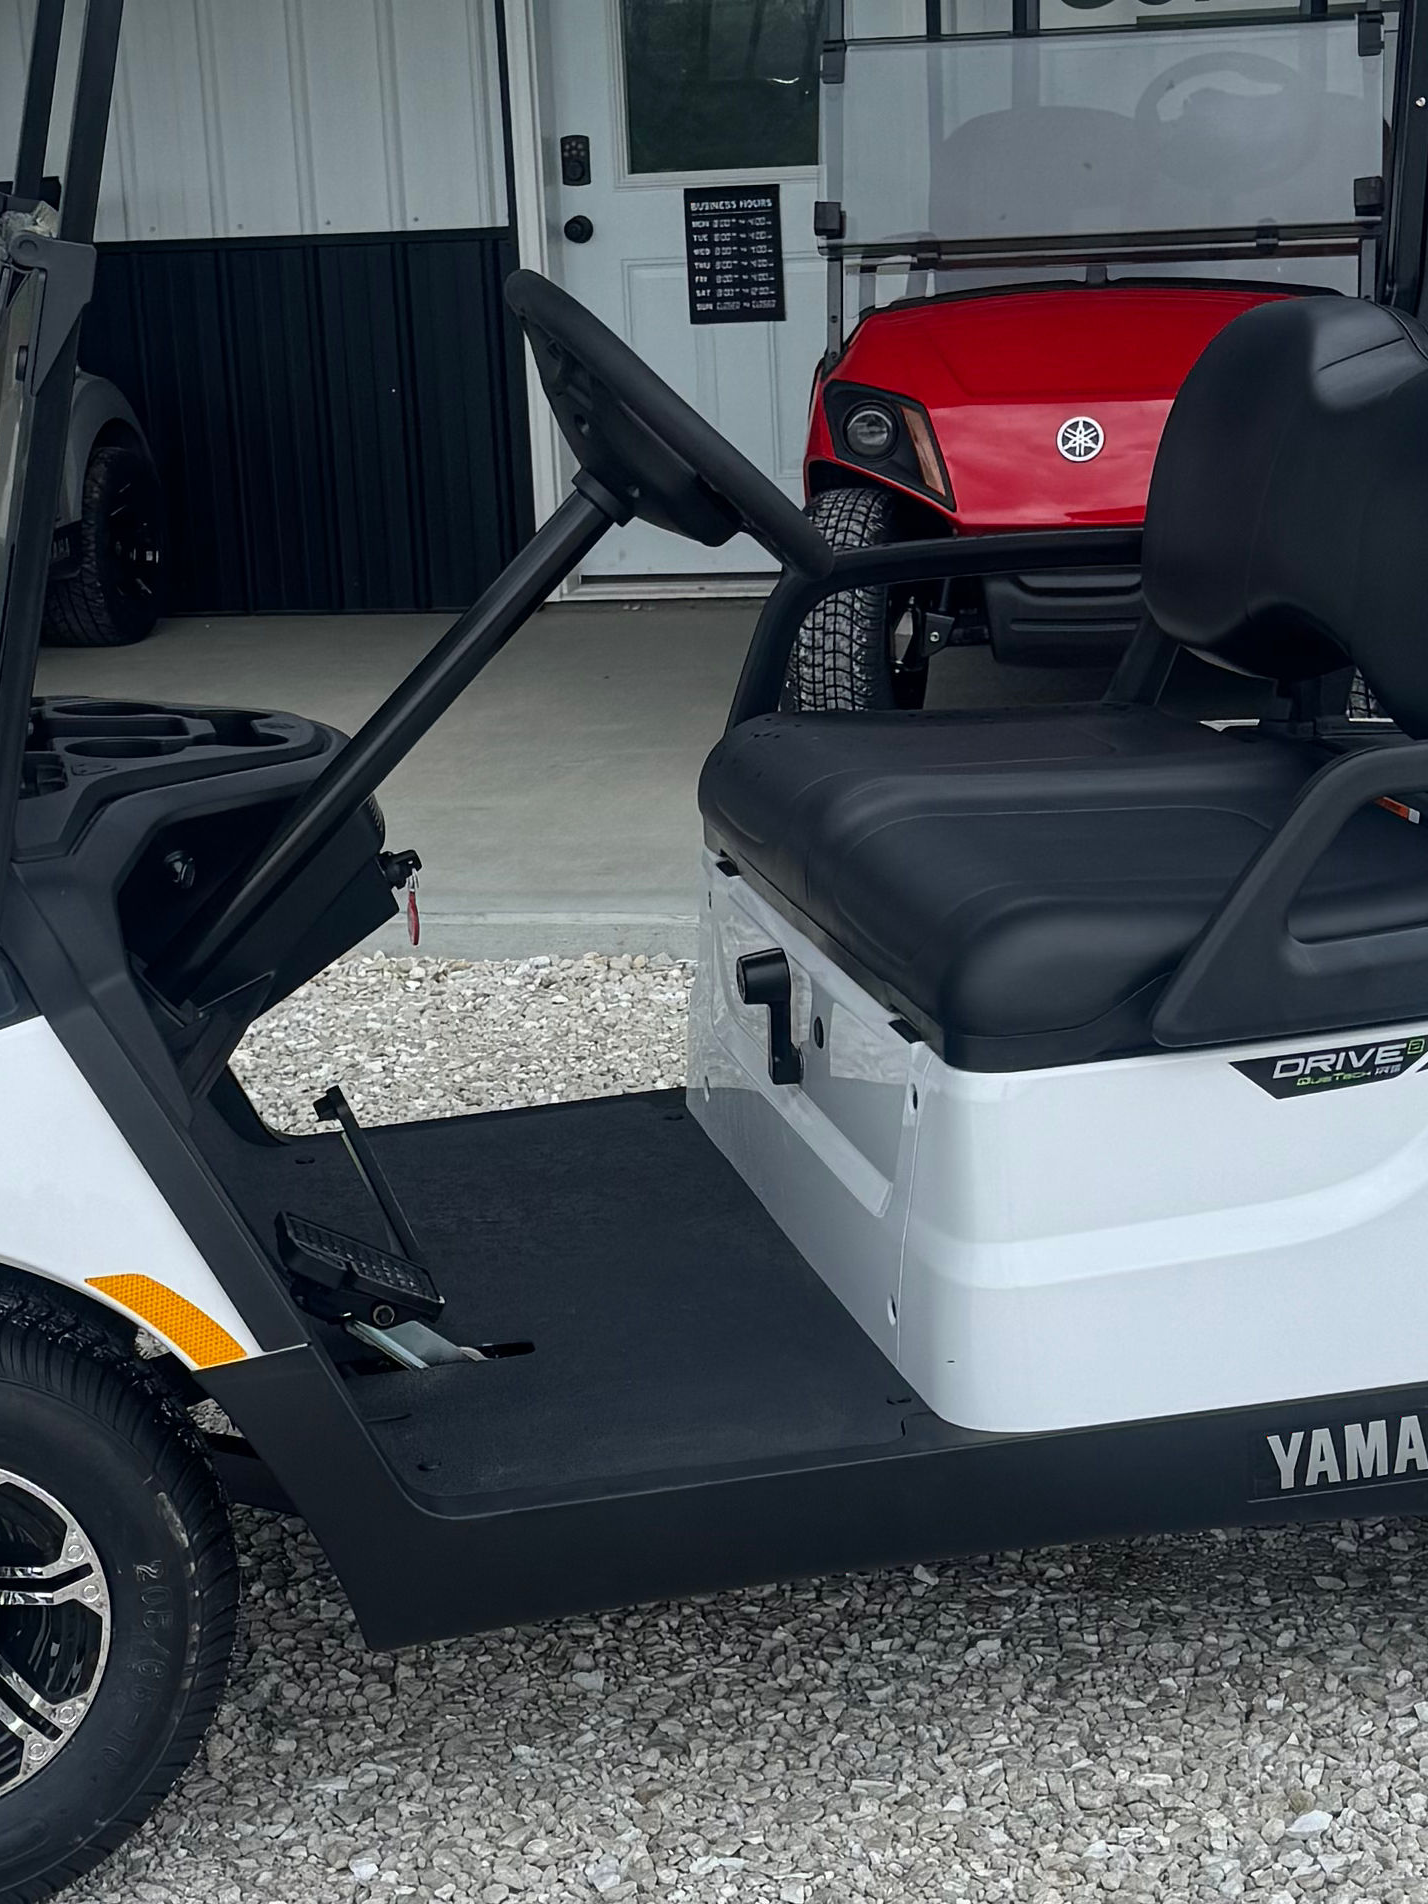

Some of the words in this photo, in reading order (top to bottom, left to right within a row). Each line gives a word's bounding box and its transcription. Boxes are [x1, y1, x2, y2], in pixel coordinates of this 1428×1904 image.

[690, 200, 737, 211] BUSINESS
[739, 198, 773, 208] HOURS
[1272, 1043, 1408, 1080] DRIVE
